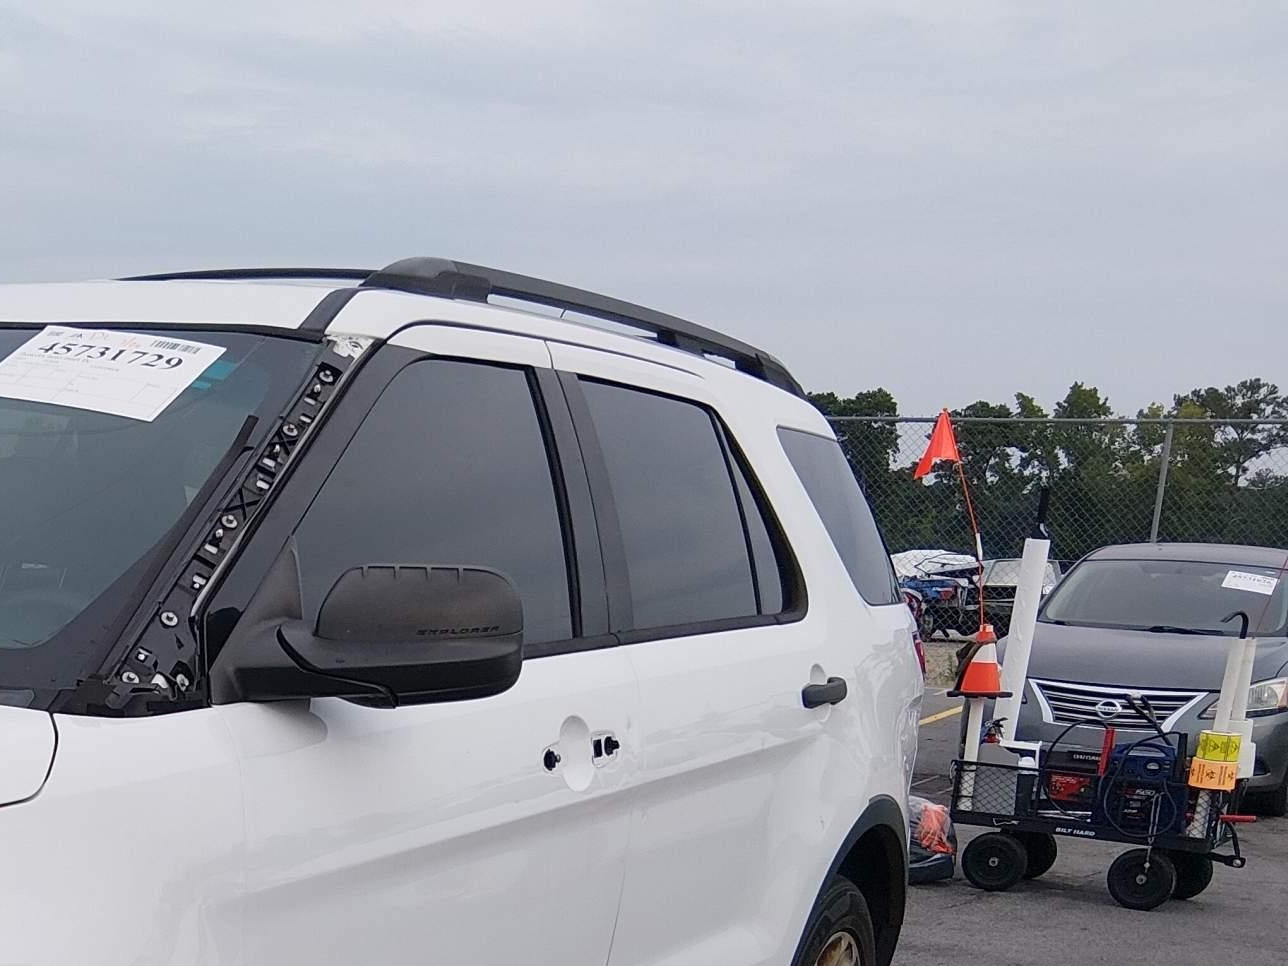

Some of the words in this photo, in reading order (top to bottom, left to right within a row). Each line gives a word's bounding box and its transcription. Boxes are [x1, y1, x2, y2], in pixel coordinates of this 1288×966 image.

[38, 342, 183, 370] 45731729
[415, 625, 501, 636] EXPLORER
[1073, 829, 1096, 837] HARD
